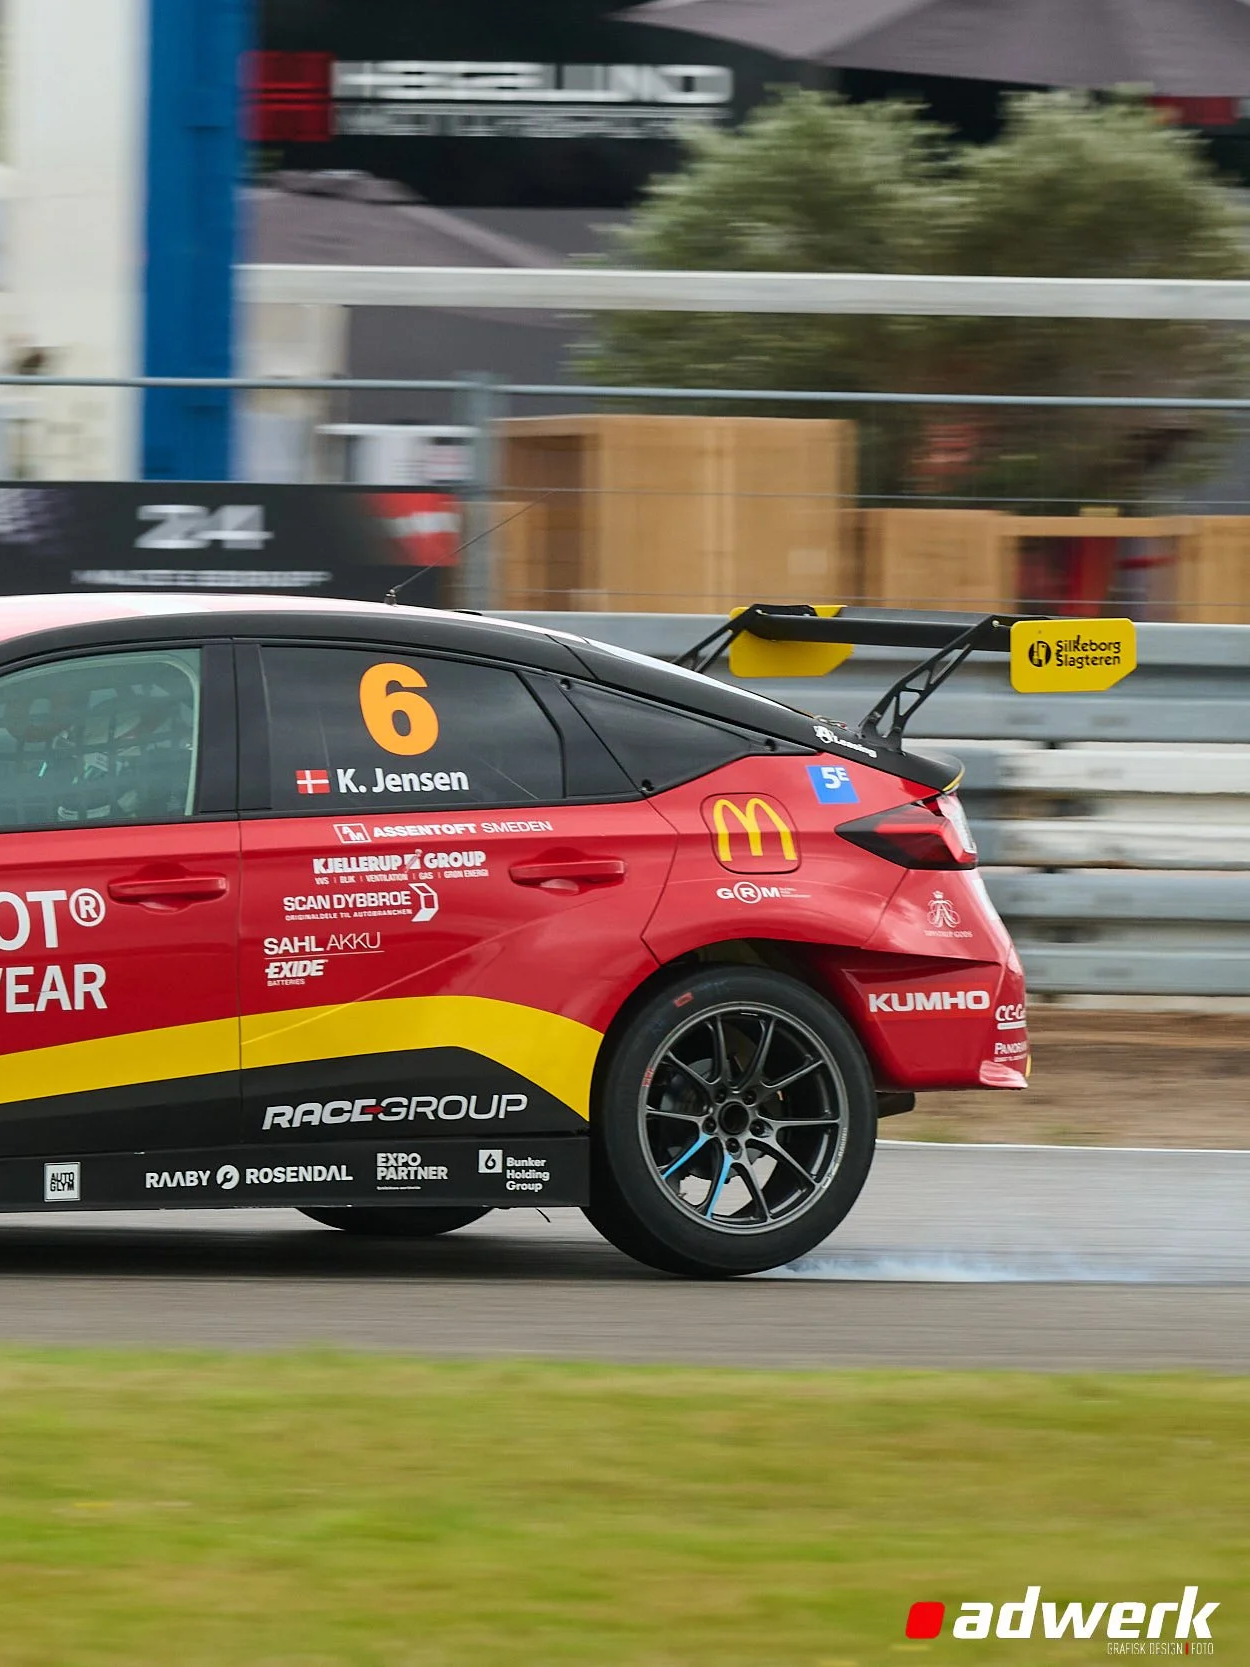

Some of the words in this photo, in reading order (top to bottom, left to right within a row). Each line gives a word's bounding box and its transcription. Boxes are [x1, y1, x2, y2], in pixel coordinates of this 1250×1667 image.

[1055, 635, 1121, 654] Silkeborg
[1055, 651, 1121, 669] Slagteren
[359, 662, 439, 756] 6
[337, 768, 366, 793] K.
[371, 768, 470, 793] Jensen
[373, 823, 476, 838] ASSENTOFT
[482, 821, 554, 834] SMEDEN
[312, 854, 403, 874] KJELLERUP
[423, 851, 486, 869] GROUP
[283, 894, 330, 912] SCAN
[333, 891, 411, 910] DYBBROE
[263, 935, 324, 955] SAHL
[326, 931, 381, 951] AKKU
[265, 959, 326, 979] EXIDE
[267, 978, 306, 987] BATTERIES
[868, 990, 991, 1013] KUMHO
[376, 1153, 422, 1167] EXPO
[506, 1157, 546, 1167] Bunker
[50, 1171, 75, 1183] AUTO
[145, 1169, 211, 1188] RAABY
[245, 1164, 353, 1185] ROSENDAL
[376, 1166, 449, 1180] PARTNER
[506, 1169, 550, 1181] Holding
[50, 1181, 75, 1192] GLYM
[506, 1181, 543, 1192] Group
